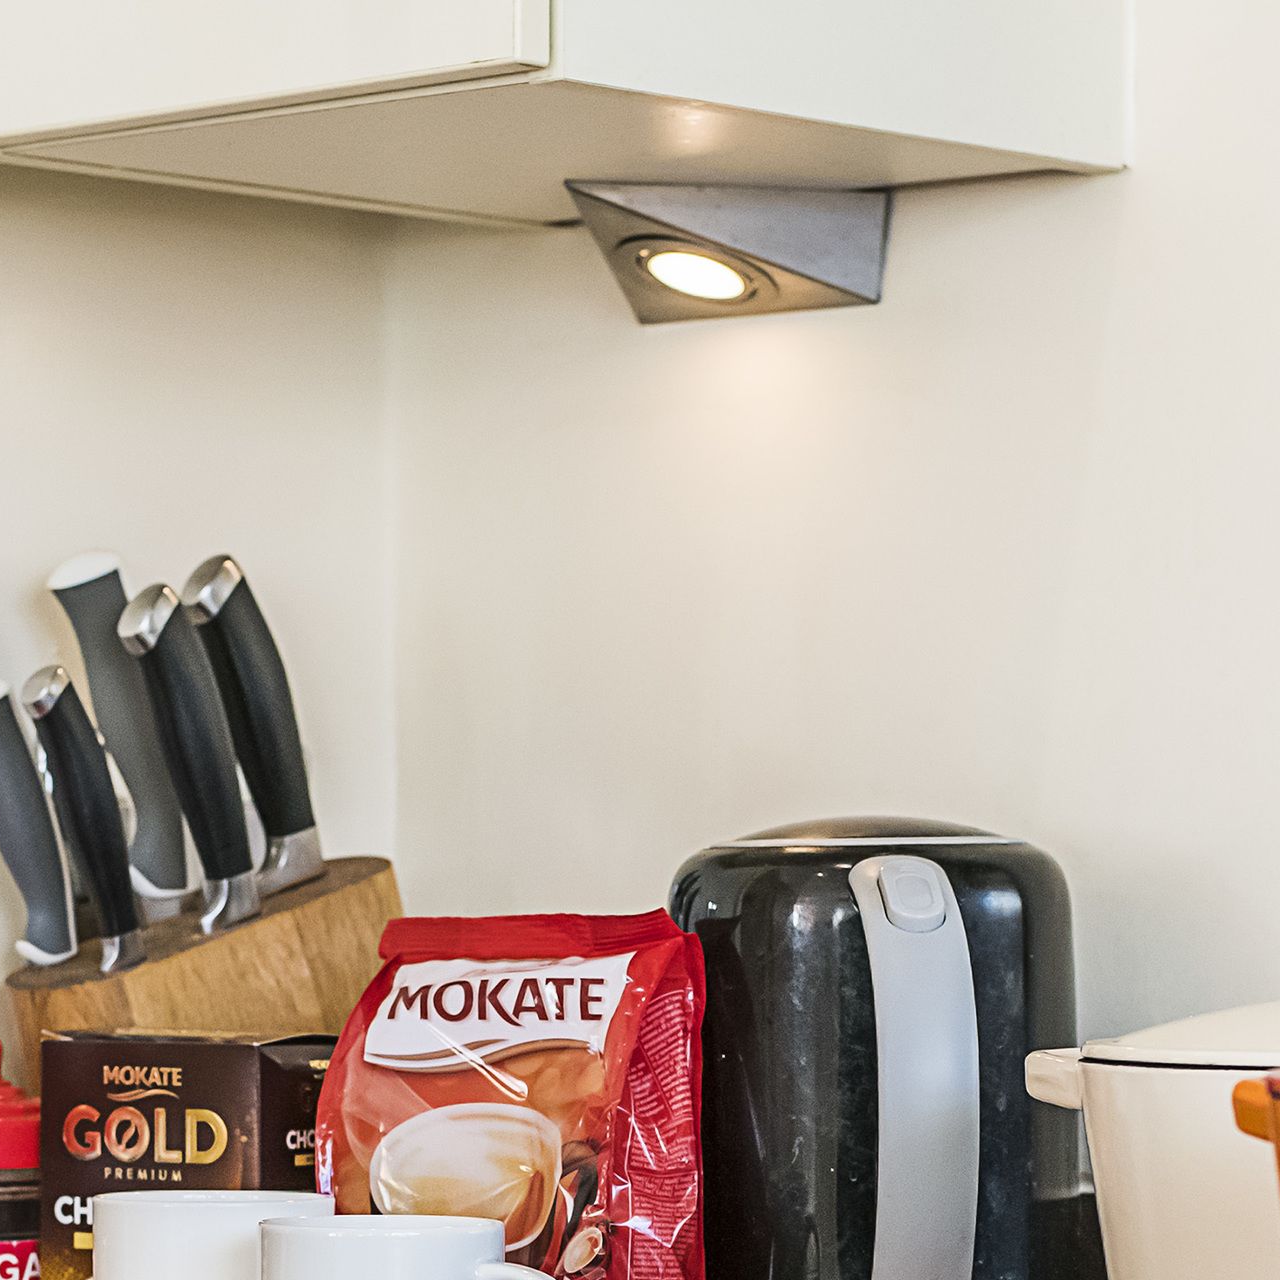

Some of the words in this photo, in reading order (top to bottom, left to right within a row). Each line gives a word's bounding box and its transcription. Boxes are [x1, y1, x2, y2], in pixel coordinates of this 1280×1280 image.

[387, 977, 605, 1027] MOKATE
[103, 1065, 182, 1087] MOKATE
[62, 1104, 228, 1164] GOLD
[104, 1167, 182, 1181] PREMIUM
